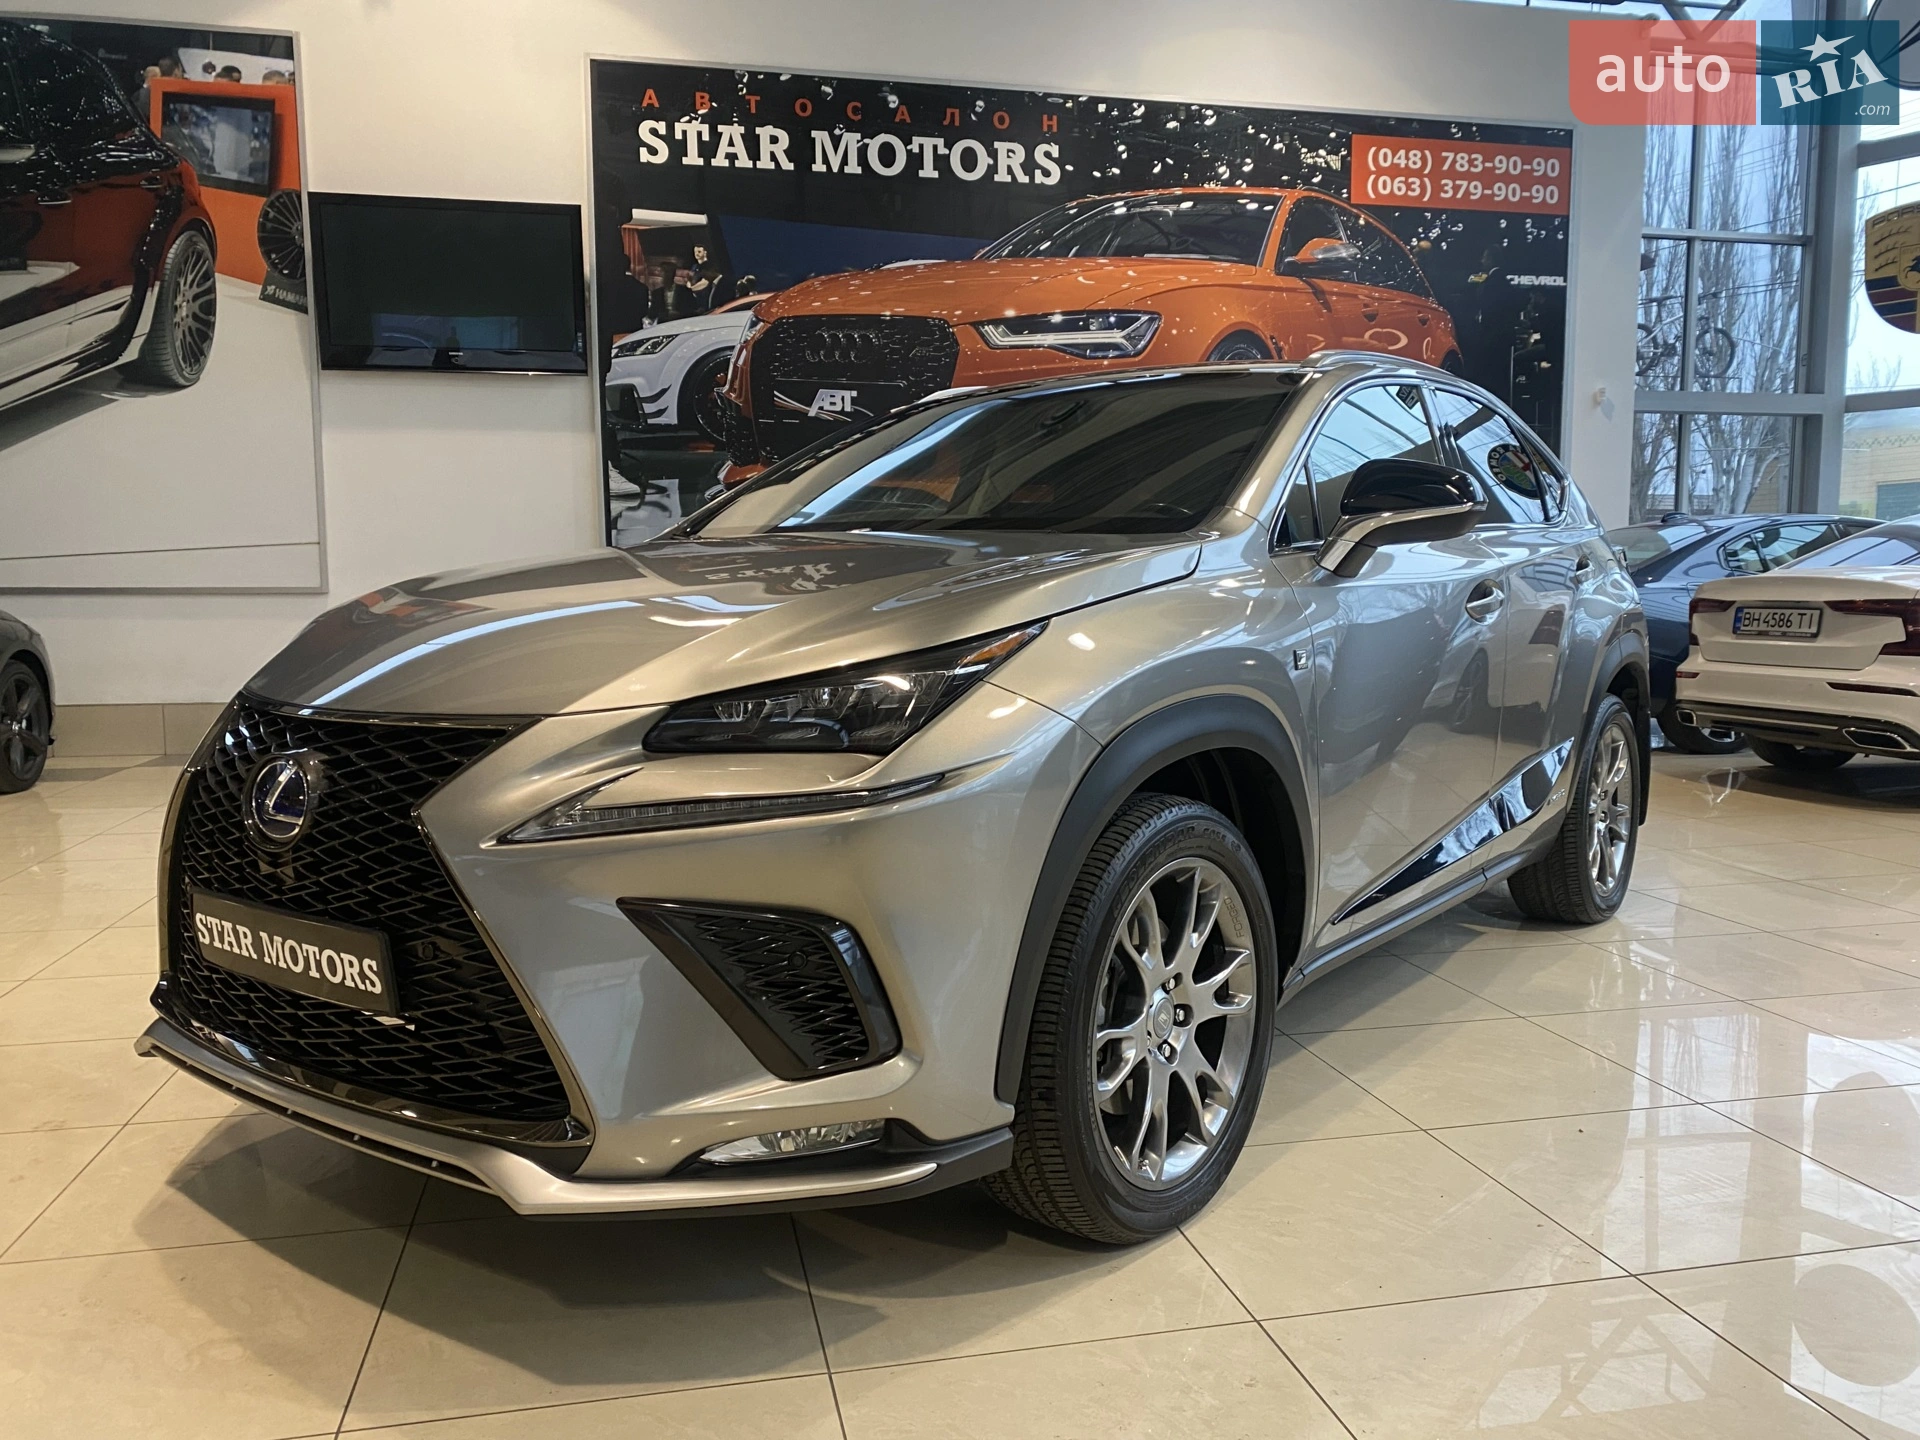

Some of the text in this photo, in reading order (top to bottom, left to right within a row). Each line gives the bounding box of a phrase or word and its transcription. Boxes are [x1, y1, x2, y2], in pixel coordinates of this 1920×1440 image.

[641, 88, 1058, 133] АВТОСАЛОН
[638, 119, 1062, 186] STAR MOTORS
[1367, 146, 1560, 177] (048) 783-90-90
[1367, 174, 1559, 204] (063) 379-90-90
[807, 388, 858, 417] ABT
[1223, 896, 1245, 938] FORGED
[195, 912, 382, 995] STAR MOTORS
